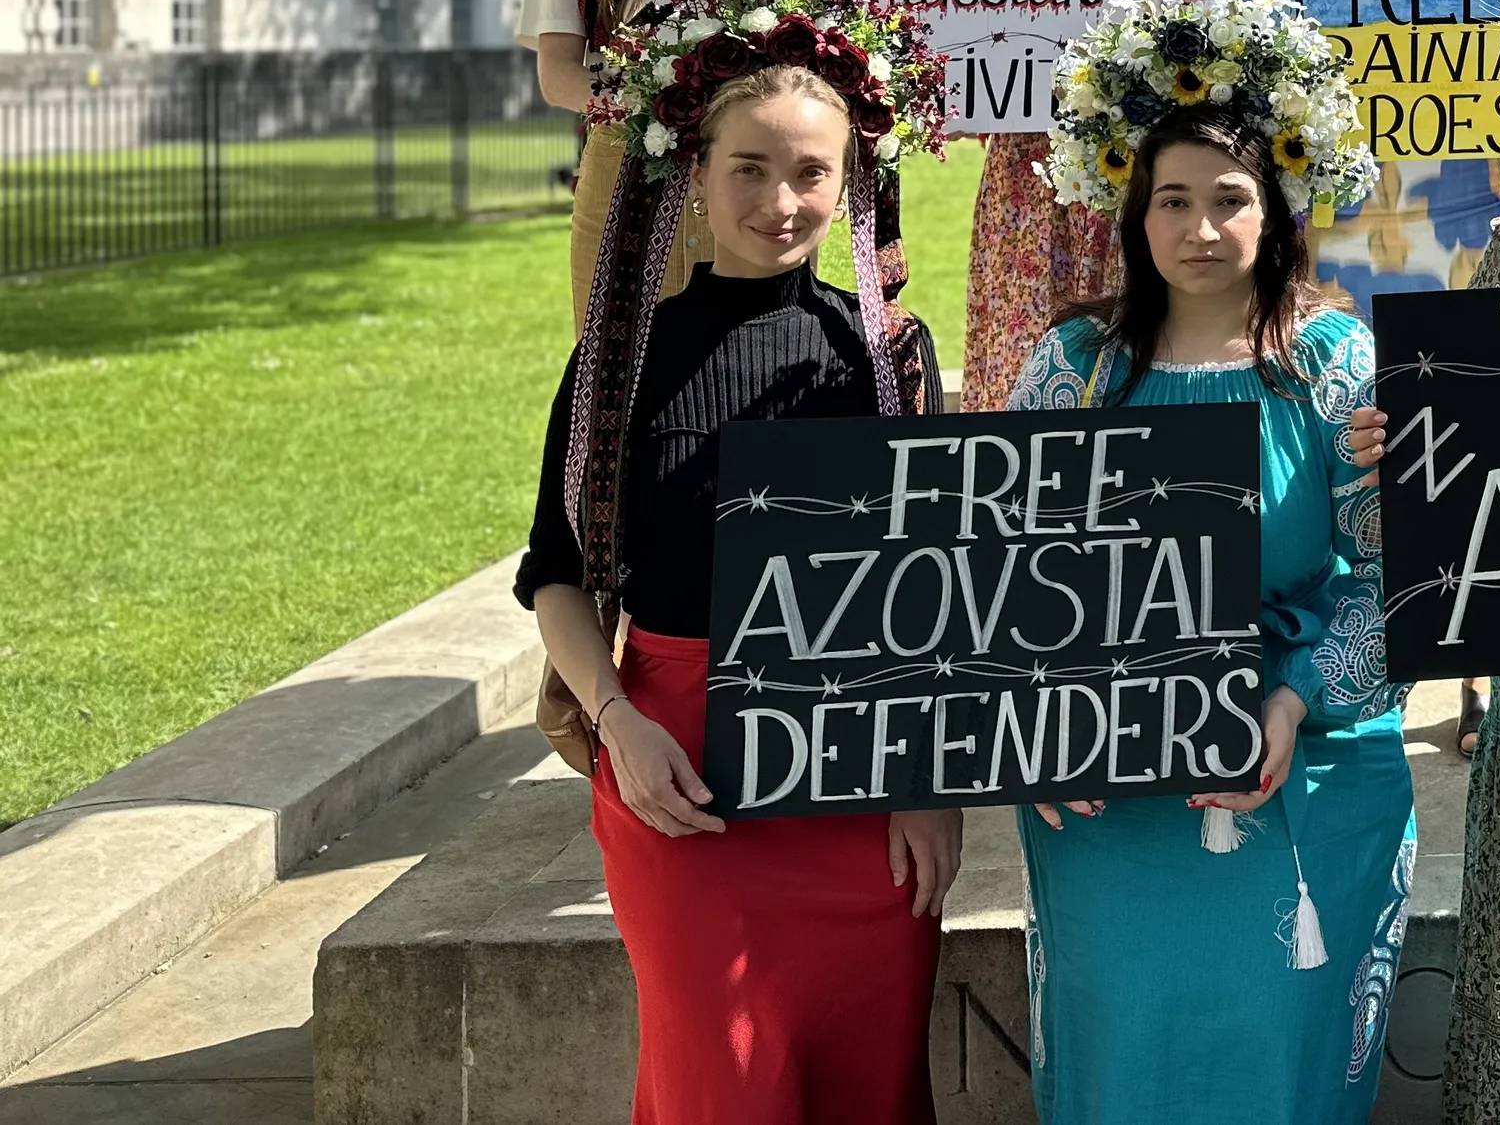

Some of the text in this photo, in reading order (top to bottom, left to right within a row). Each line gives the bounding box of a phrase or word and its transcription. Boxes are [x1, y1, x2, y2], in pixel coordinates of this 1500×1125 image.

[883, 427, 1152, 539] FREE
[717, 536, 1260, 666] AZOVSTAL
[735, 668, 1262, 809] DEFENDERS
